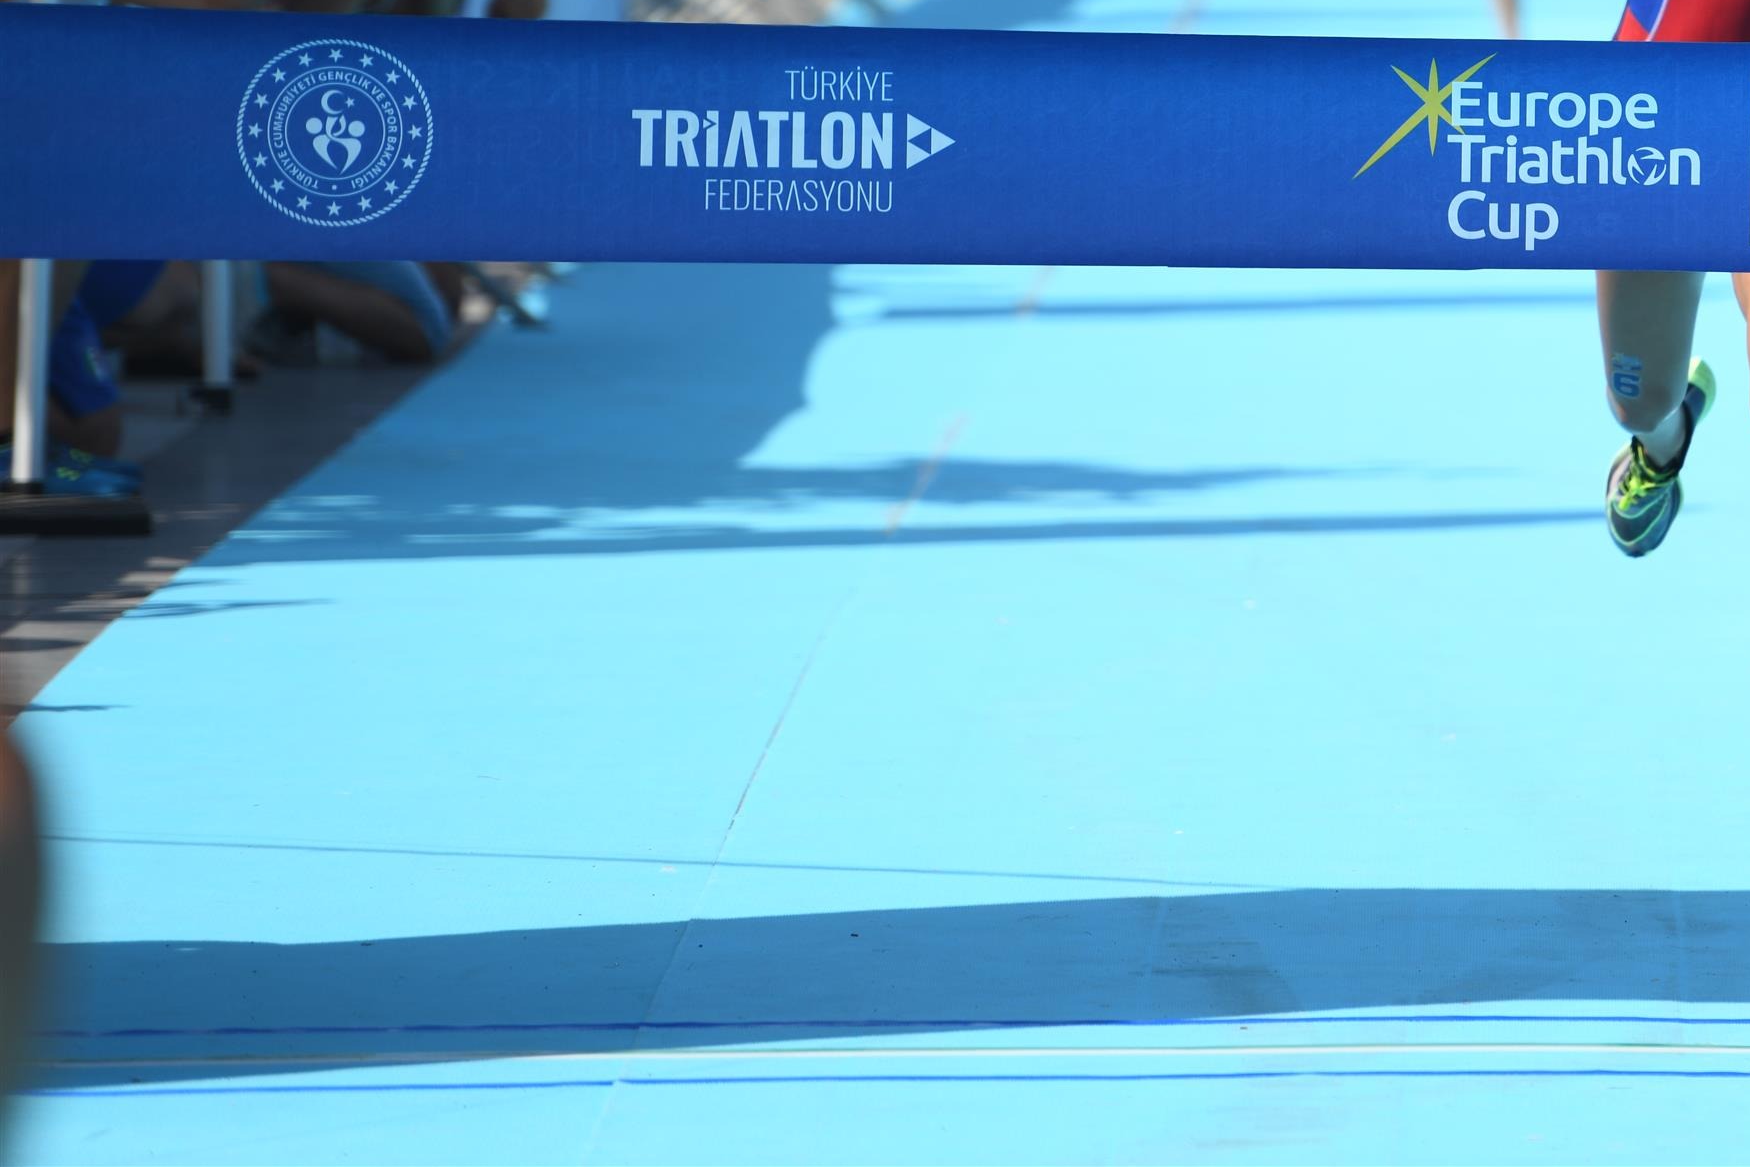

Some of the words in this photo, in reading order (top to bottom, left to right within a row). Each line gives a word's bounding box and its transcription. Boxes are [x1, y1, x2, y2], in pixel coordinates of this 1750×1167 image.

[318, 70, 371, 90] GENÇLİK
[371, 86, 385, 101] VE
[785, 65, 894, 102] TÜRKİYE
[273, 73, 317, 149] CUMHURİYETİ
[381, 101, 398, 133] SPOR
[1451, 81, 1658, 136] Europe
[278, 149, 319, 190] TÜRKİYE
[1447, 134, 1701, 185] Triathlon
[705, 179, 893, 213] FEDERASYONU
[1447, 190, 1559, 251] Cup
